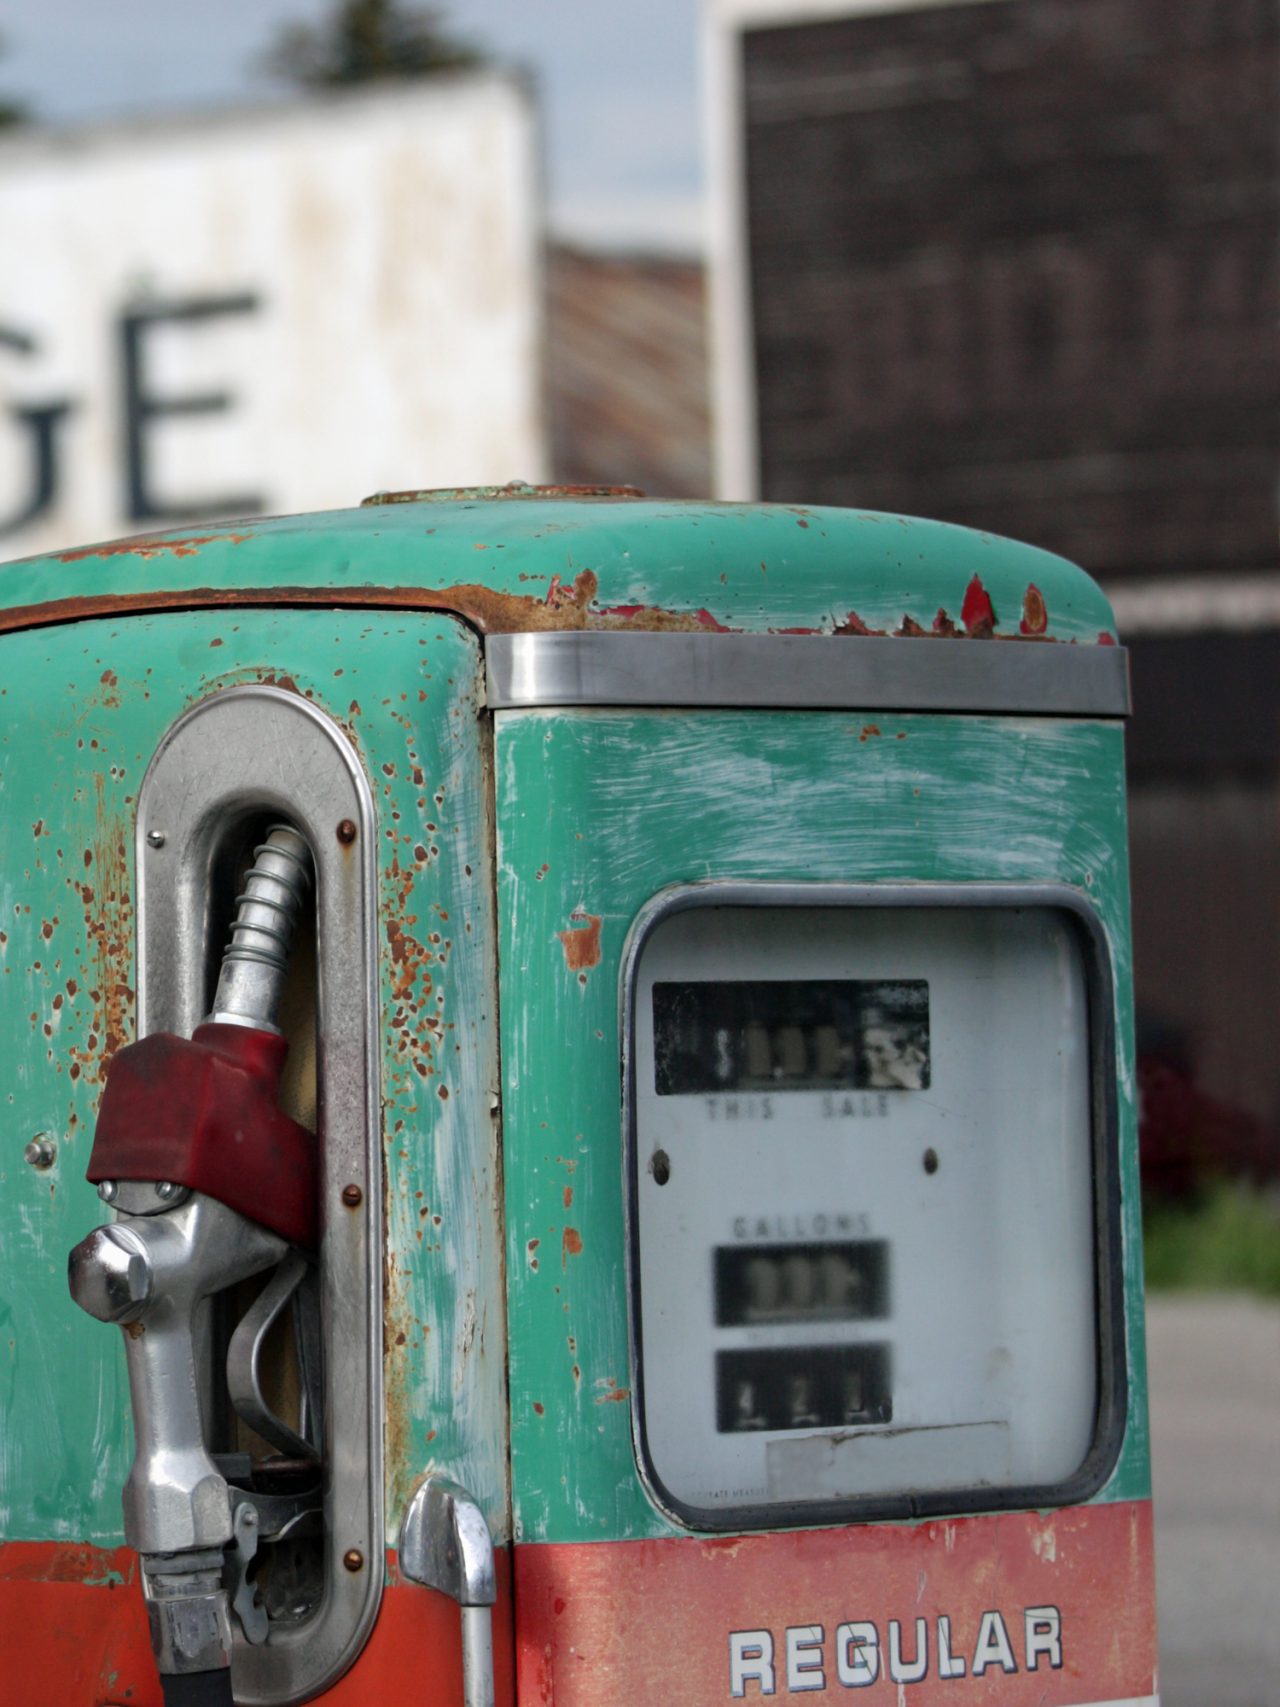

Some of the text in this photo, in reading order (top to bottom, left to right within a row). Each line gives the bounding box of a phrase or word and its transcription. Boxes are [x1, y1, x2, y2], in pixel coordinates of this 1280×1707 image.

[707, 1095, 890, 1121] THIS SALE
[732, 1213, 872, 1238] GALLONS
[728, 1604, 1063, 1698] REGULAR
